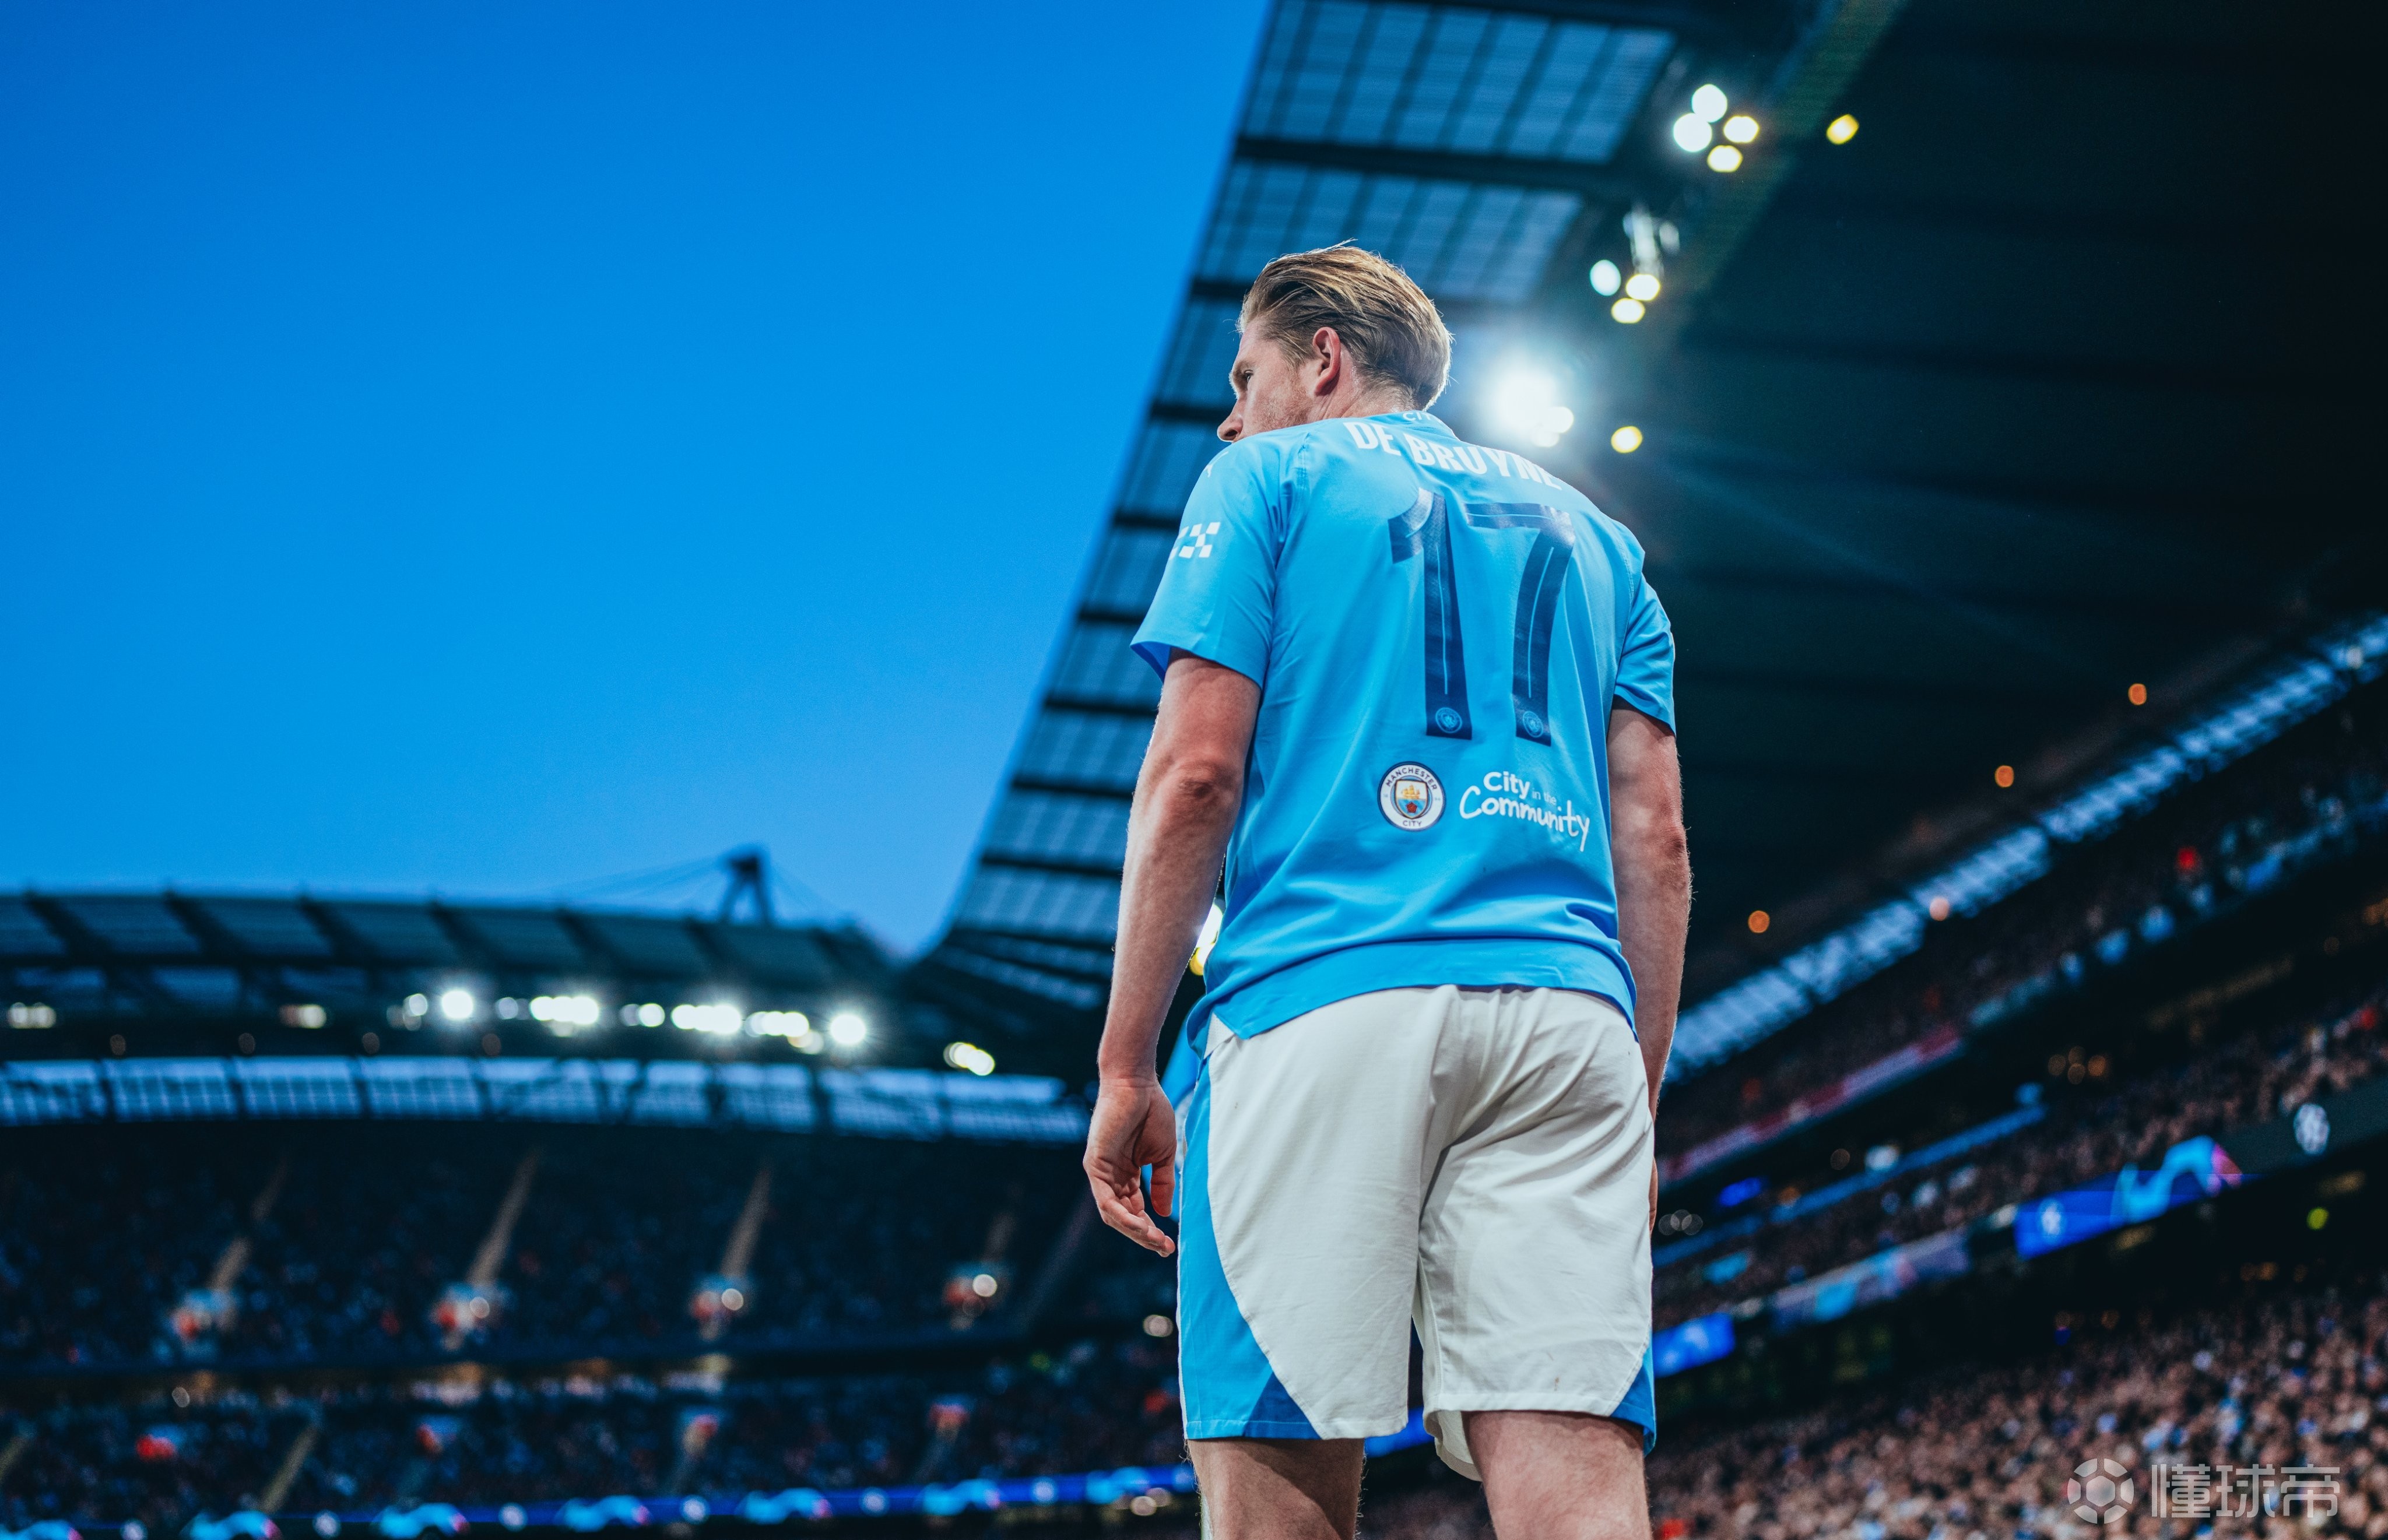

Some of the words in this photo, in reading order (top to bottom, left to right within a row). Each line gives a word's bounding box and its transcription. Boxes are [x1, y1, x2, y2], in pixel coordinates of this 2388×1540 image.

[1403, 411, 1432, 421] CIT
[1343, 421, 1402, 456] DE
[1403, 433, 1562, 490] BRUYNE
[1388, 487, 1575, 747] 17
[1386, 767, 1438, 790] MANCHESTER
[1483, 771, 1529, 799] City
[1532, 787, 1541, 800] in
[1459, 785, 1590, 852] Community
